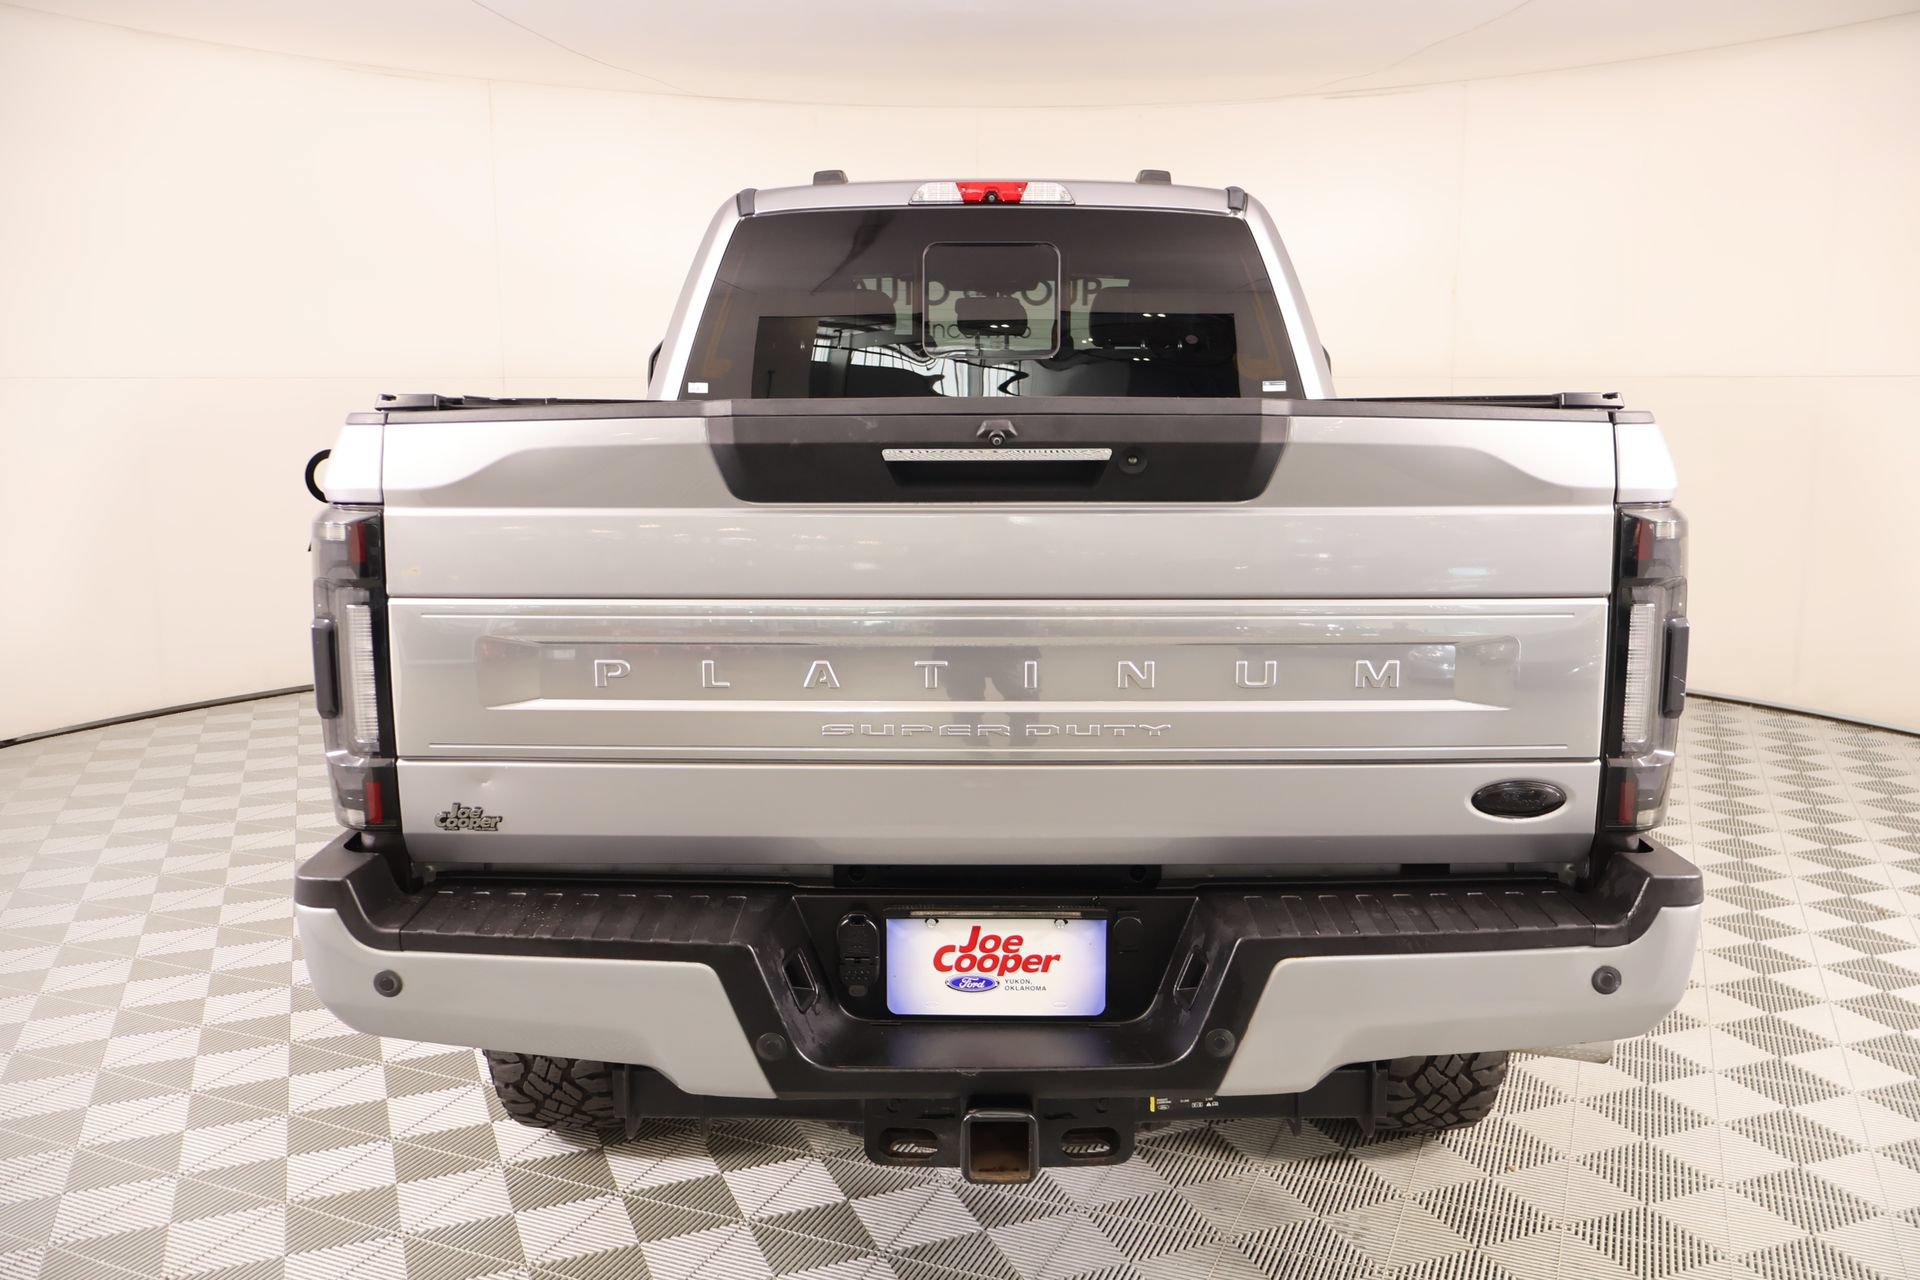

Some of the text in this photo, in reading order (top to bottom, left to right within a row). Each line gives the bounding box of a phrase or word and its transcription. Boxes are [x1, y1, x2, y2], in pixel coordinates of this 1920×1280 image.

[964, 277, 1102, 306] OUP
[594, 659, 1401, 689] PLATINUM
[822, 723, 1171, 737] SUPER DUTY
[435, 812, 503, 829] Cooper
[449, 803, 483, 818] Joe
[959, 926, 1024, 953] Joe
[934, 945, 1061, 976] Cooper
[959, 977, 986, 989] Ford
